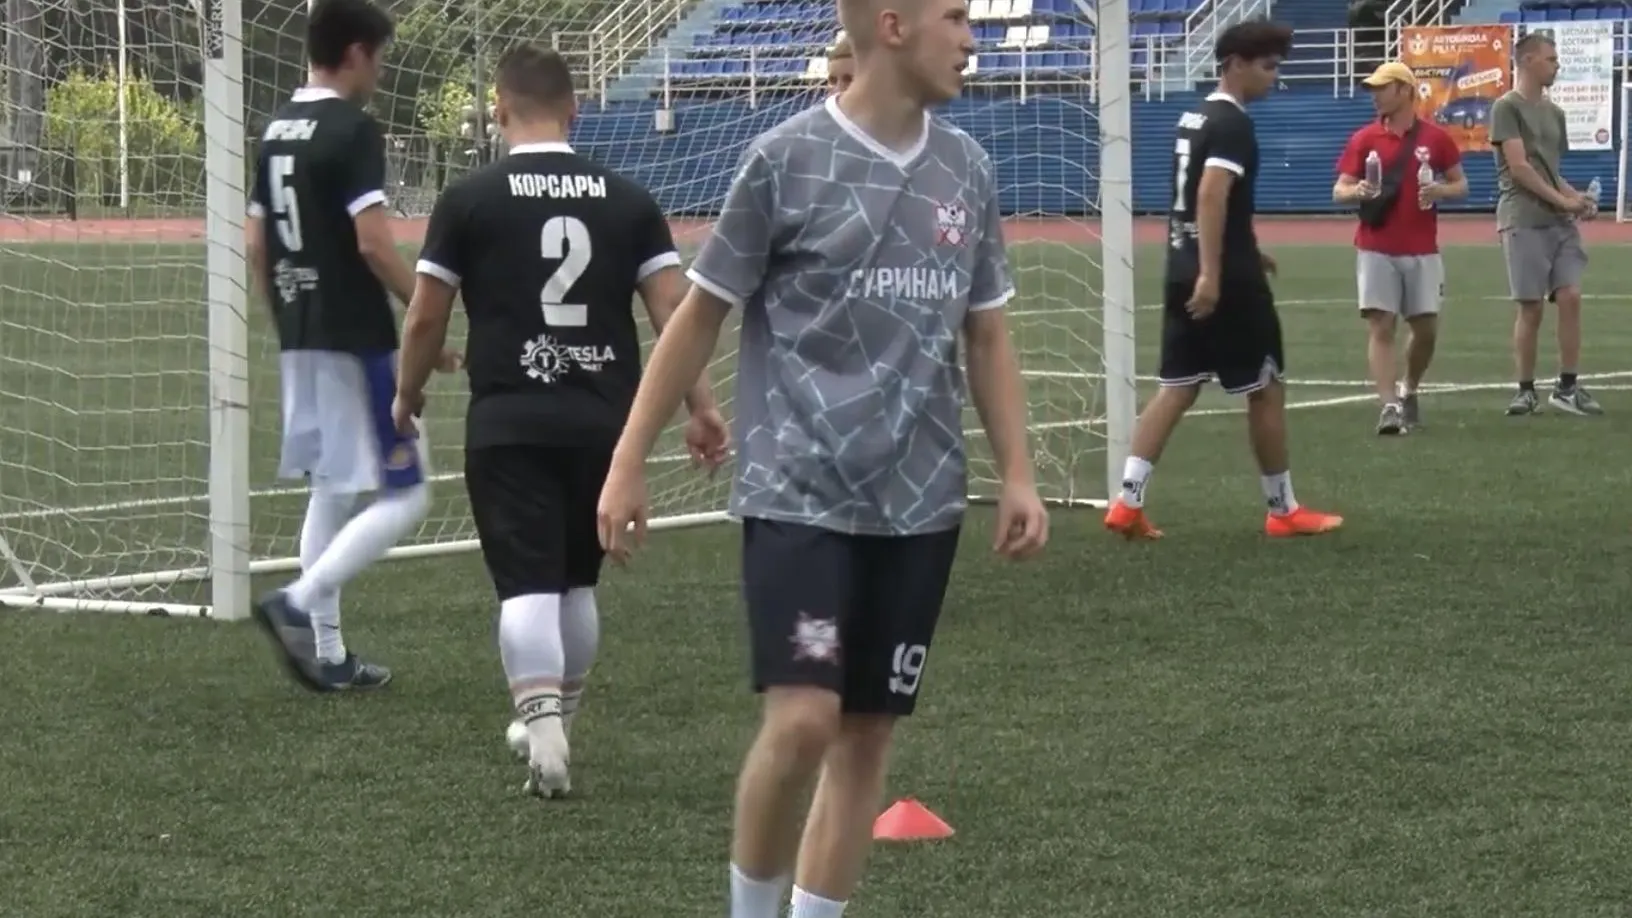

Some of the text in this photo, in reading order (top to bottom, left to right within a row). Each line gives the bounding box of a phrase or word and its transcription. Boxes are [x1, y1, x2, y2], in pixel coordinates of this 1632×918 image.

[268, 155, 303, 252] 5
[508, 173, 607, 198] КОРСАРЫ
[540, 215, 592, 327] 2
[846, 267, 958, 300] СУРИНАМ
[567, 344, 616, 362] TESLA
[889, 642, 927, 695] 19
